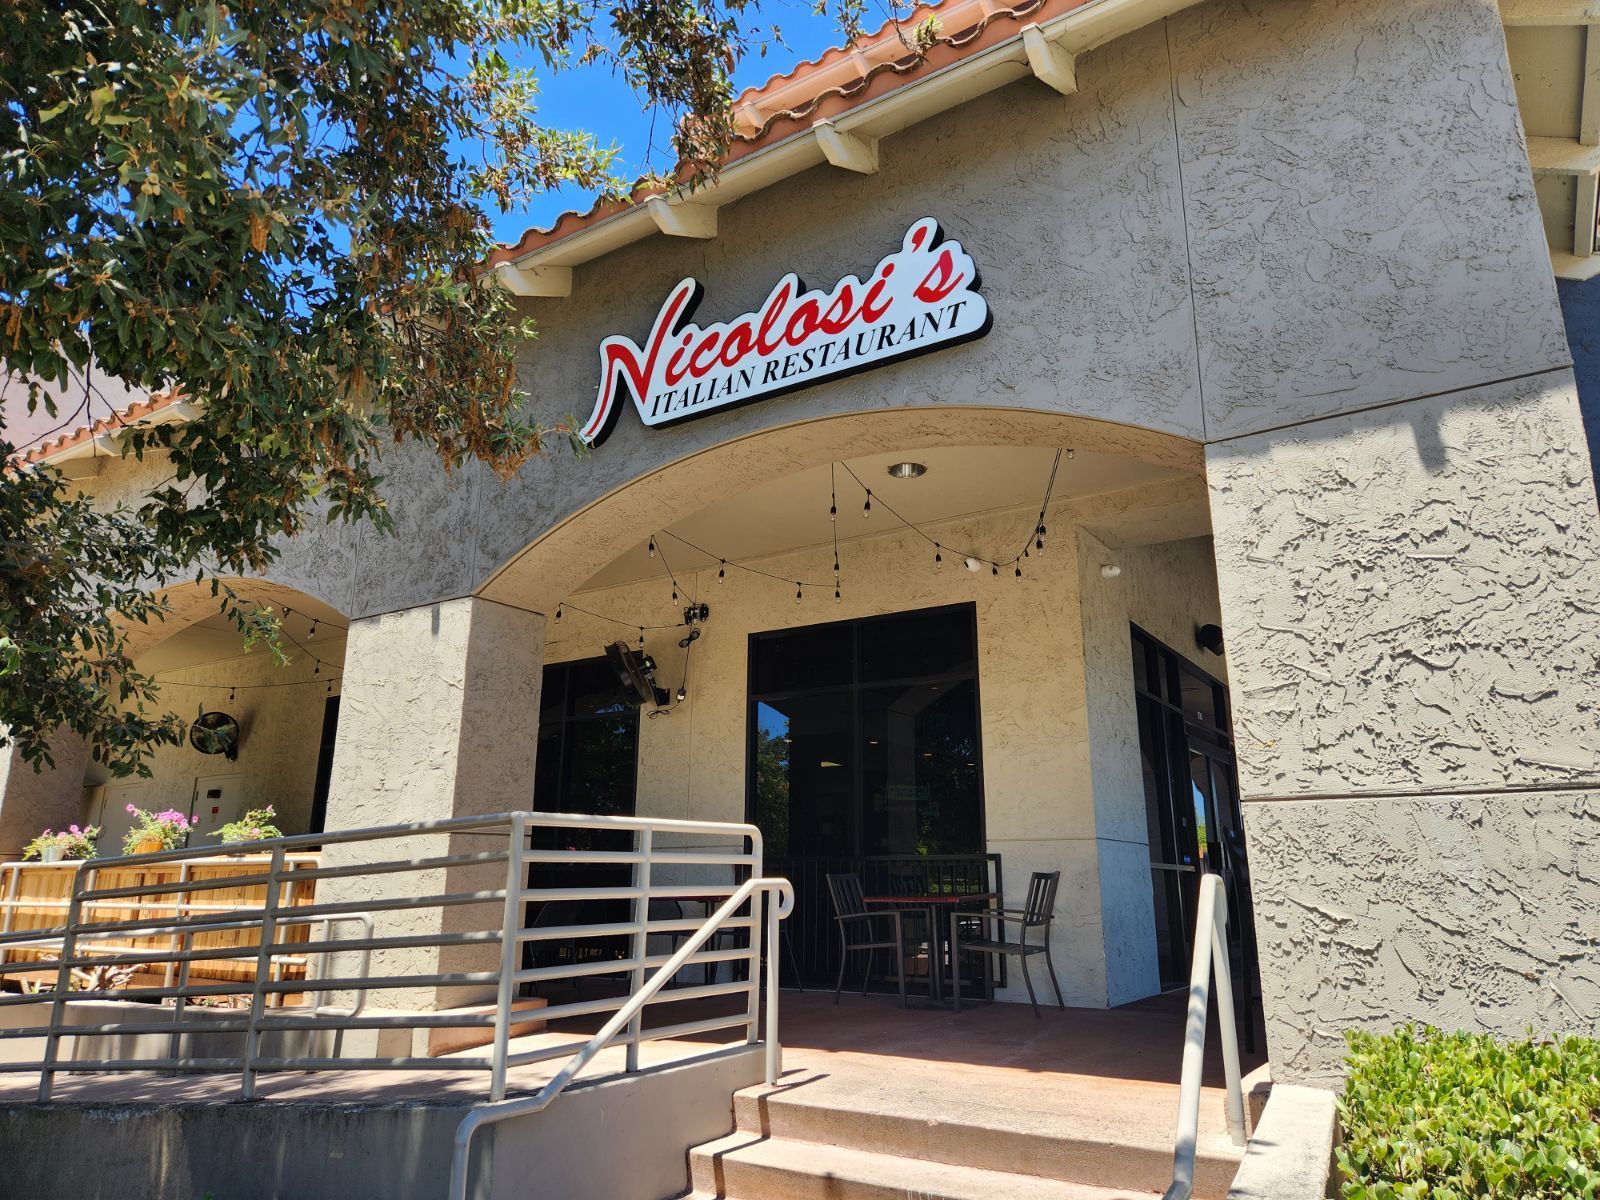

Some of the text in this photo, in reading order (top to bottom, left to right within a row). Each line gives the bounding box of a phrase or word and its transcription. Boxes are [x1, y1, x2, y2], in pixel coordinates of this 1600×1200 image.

[586, 225, 965, 436] Nicolosi's
[651, 301, 967, 417] ITALIAN RESTAURANT
